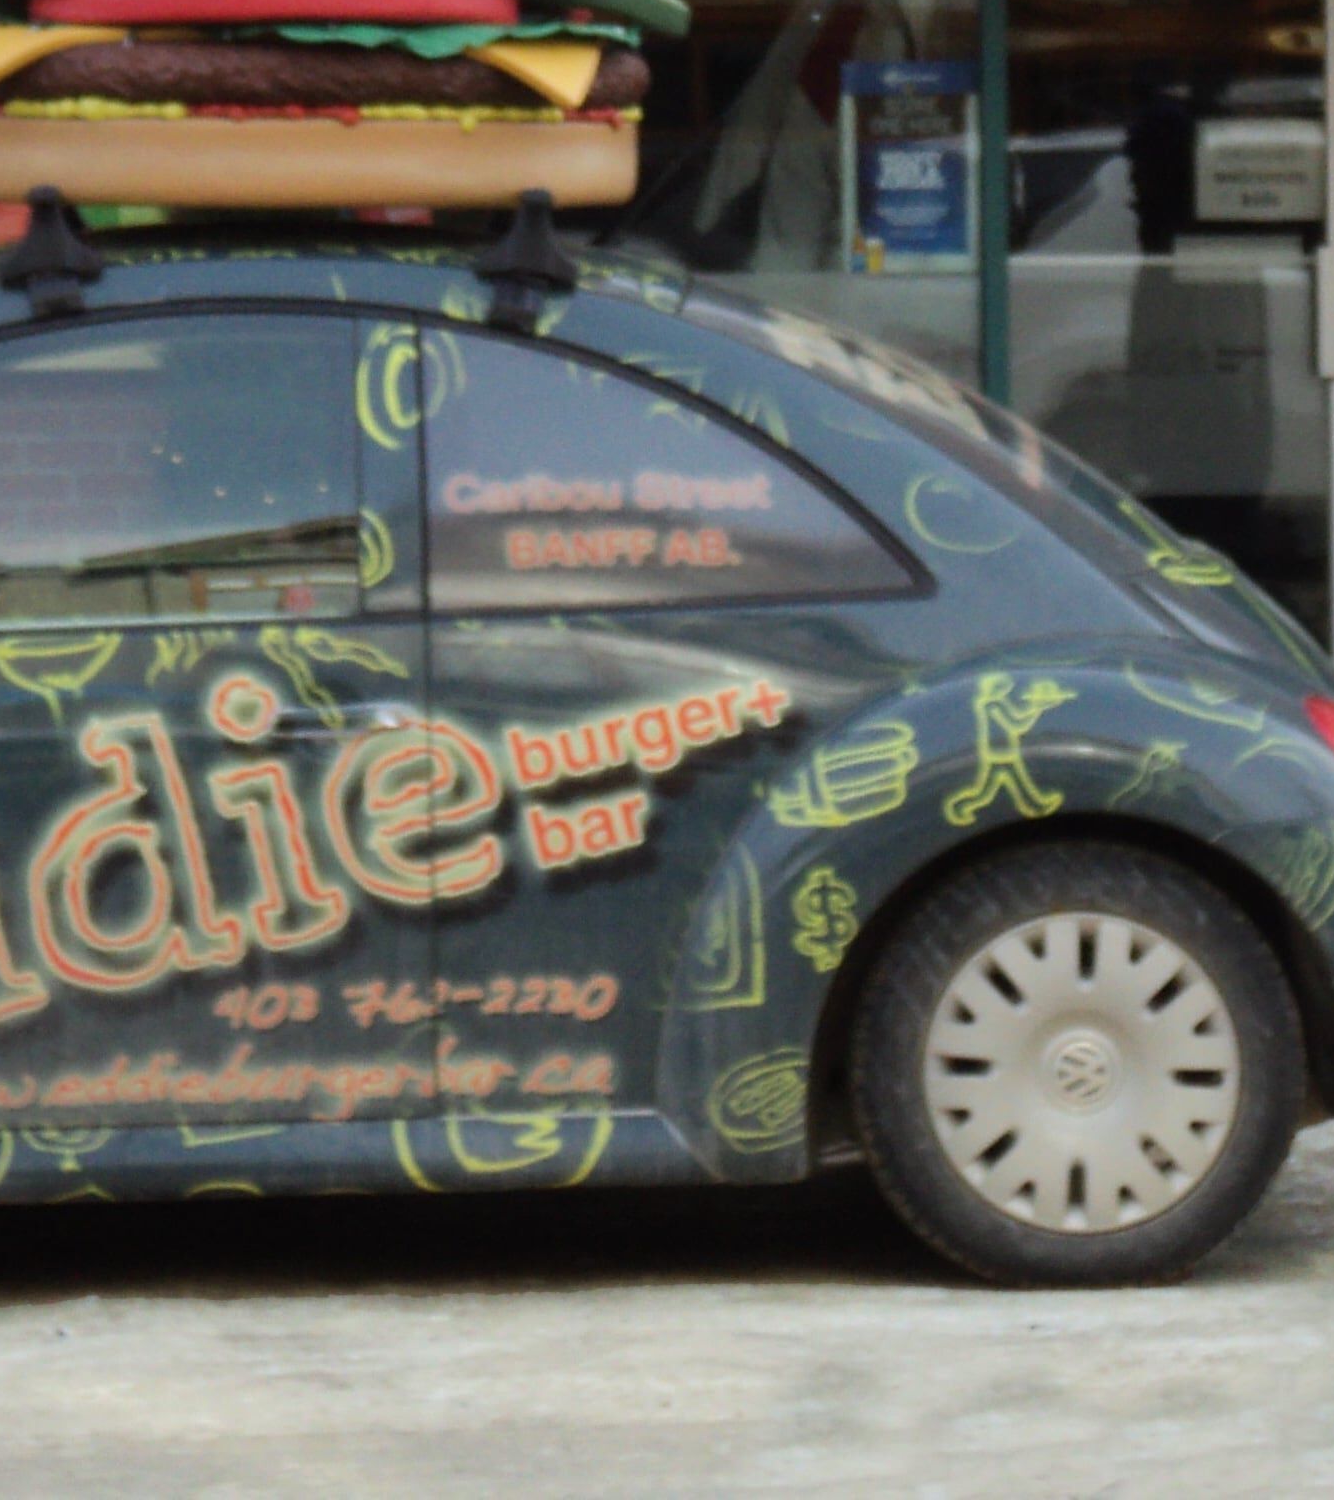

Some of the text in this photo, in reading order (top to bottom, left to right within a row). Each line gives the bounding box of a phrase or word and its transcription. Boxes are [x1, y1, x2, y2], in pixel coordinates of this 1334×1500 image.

[507, 530, 658, 569] BANFF
[504, 678, 791, 791] burger+
[524, 793, 650, 869] bar
